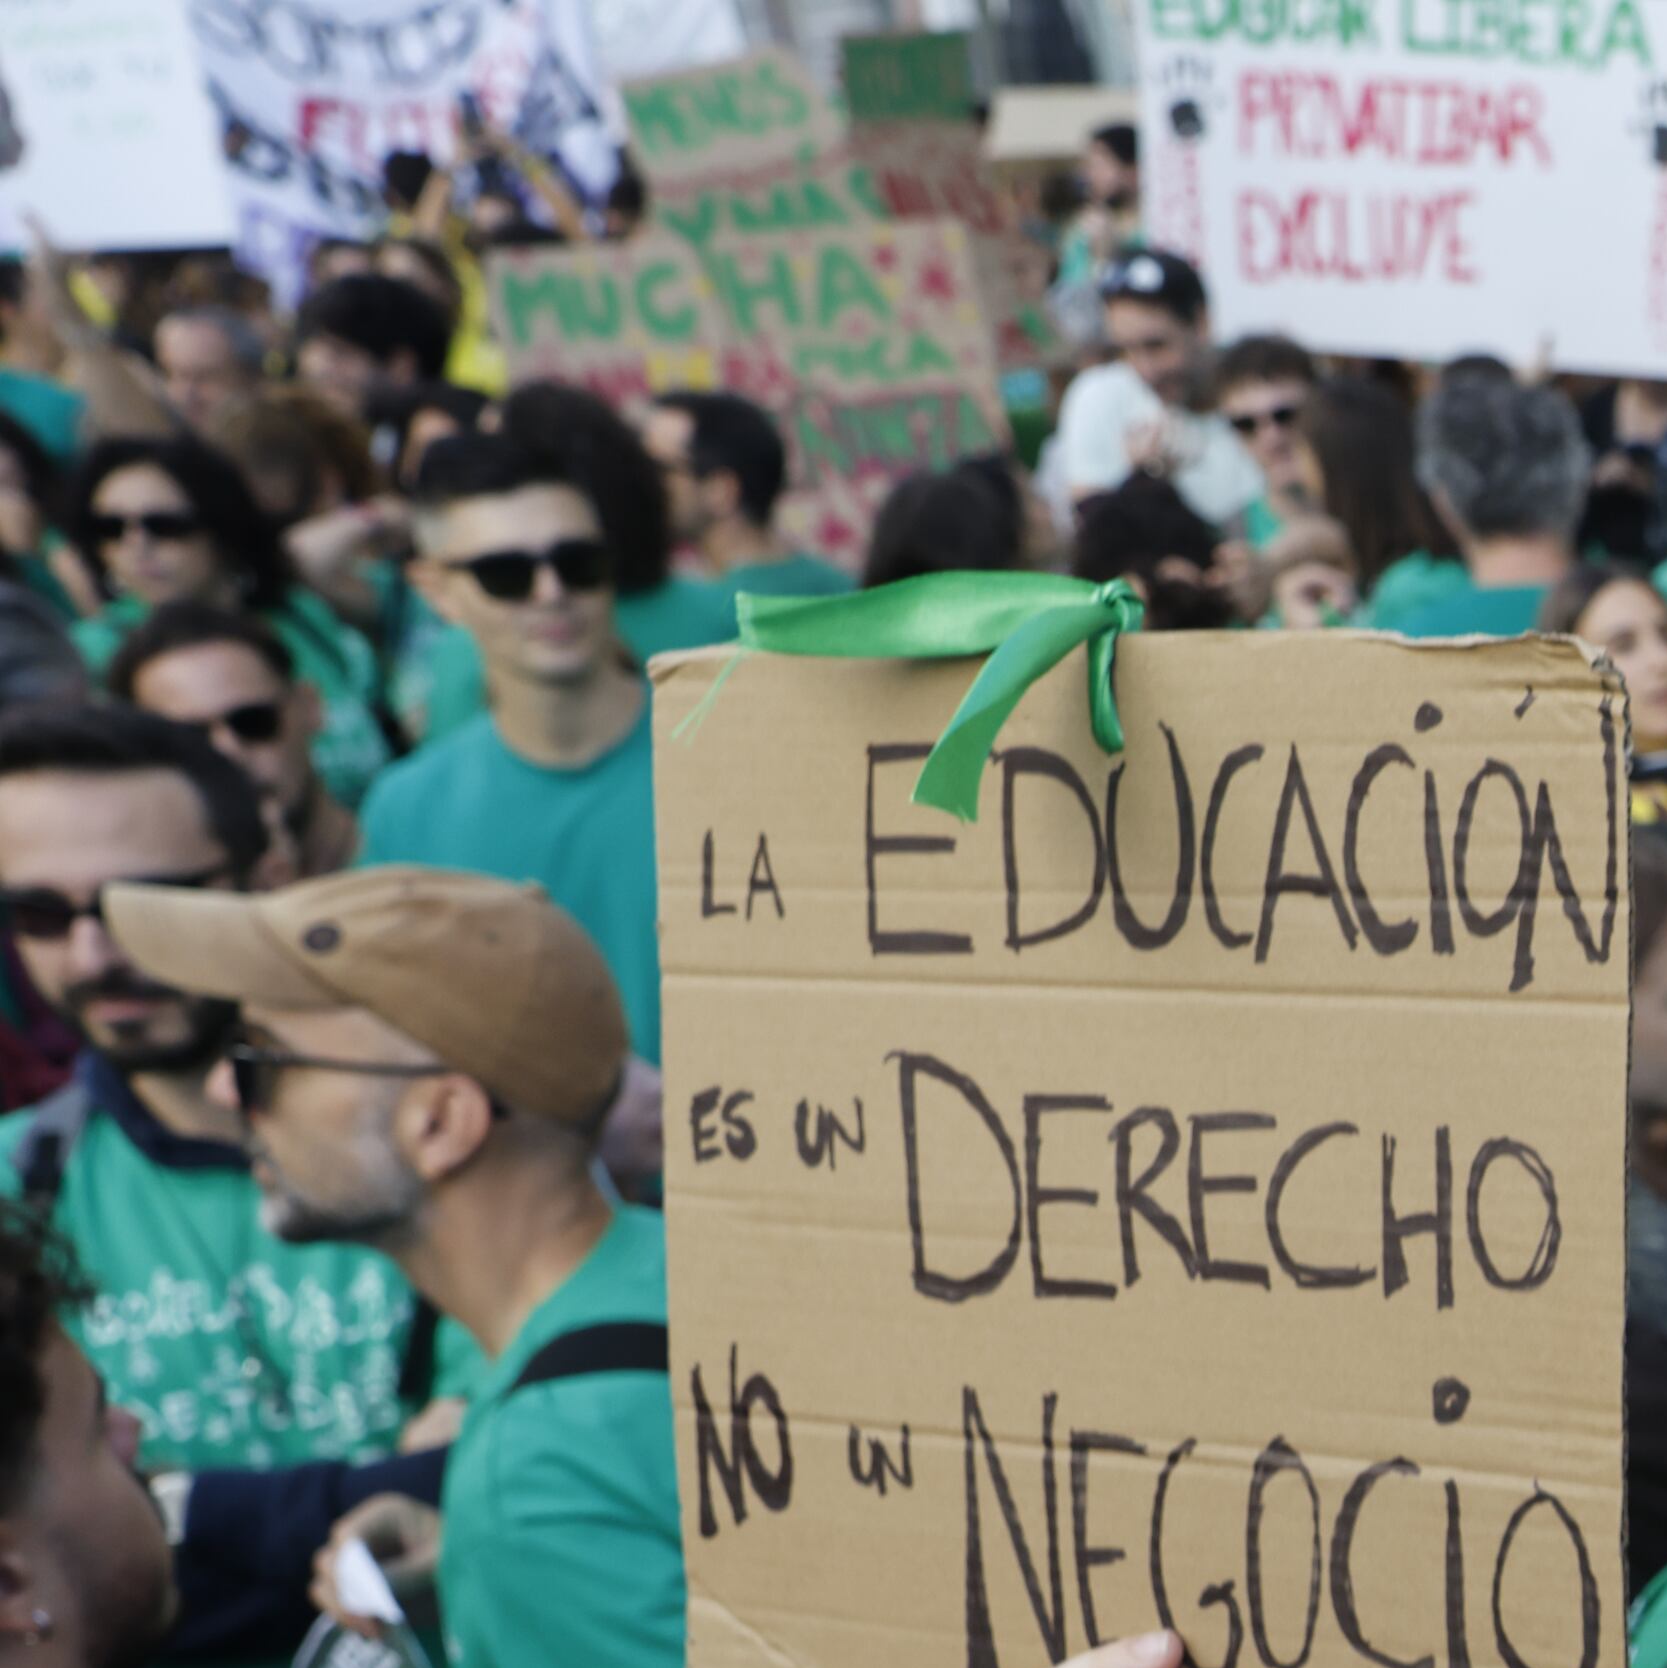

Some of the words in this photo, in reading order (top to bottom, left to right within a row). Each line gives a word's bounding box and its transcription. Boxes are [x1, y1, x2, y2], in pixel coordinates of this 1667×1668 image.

[1400, 0, 1655, 68] LIBERA
[701, 830, 784, 921] LA
[690, 1086, 756, 1163] ES
[794, 1096, 867, 1170] UN
[885, 1050, 1561, 1309] DERECHO
[690, 1343, 794, 1538] NO
